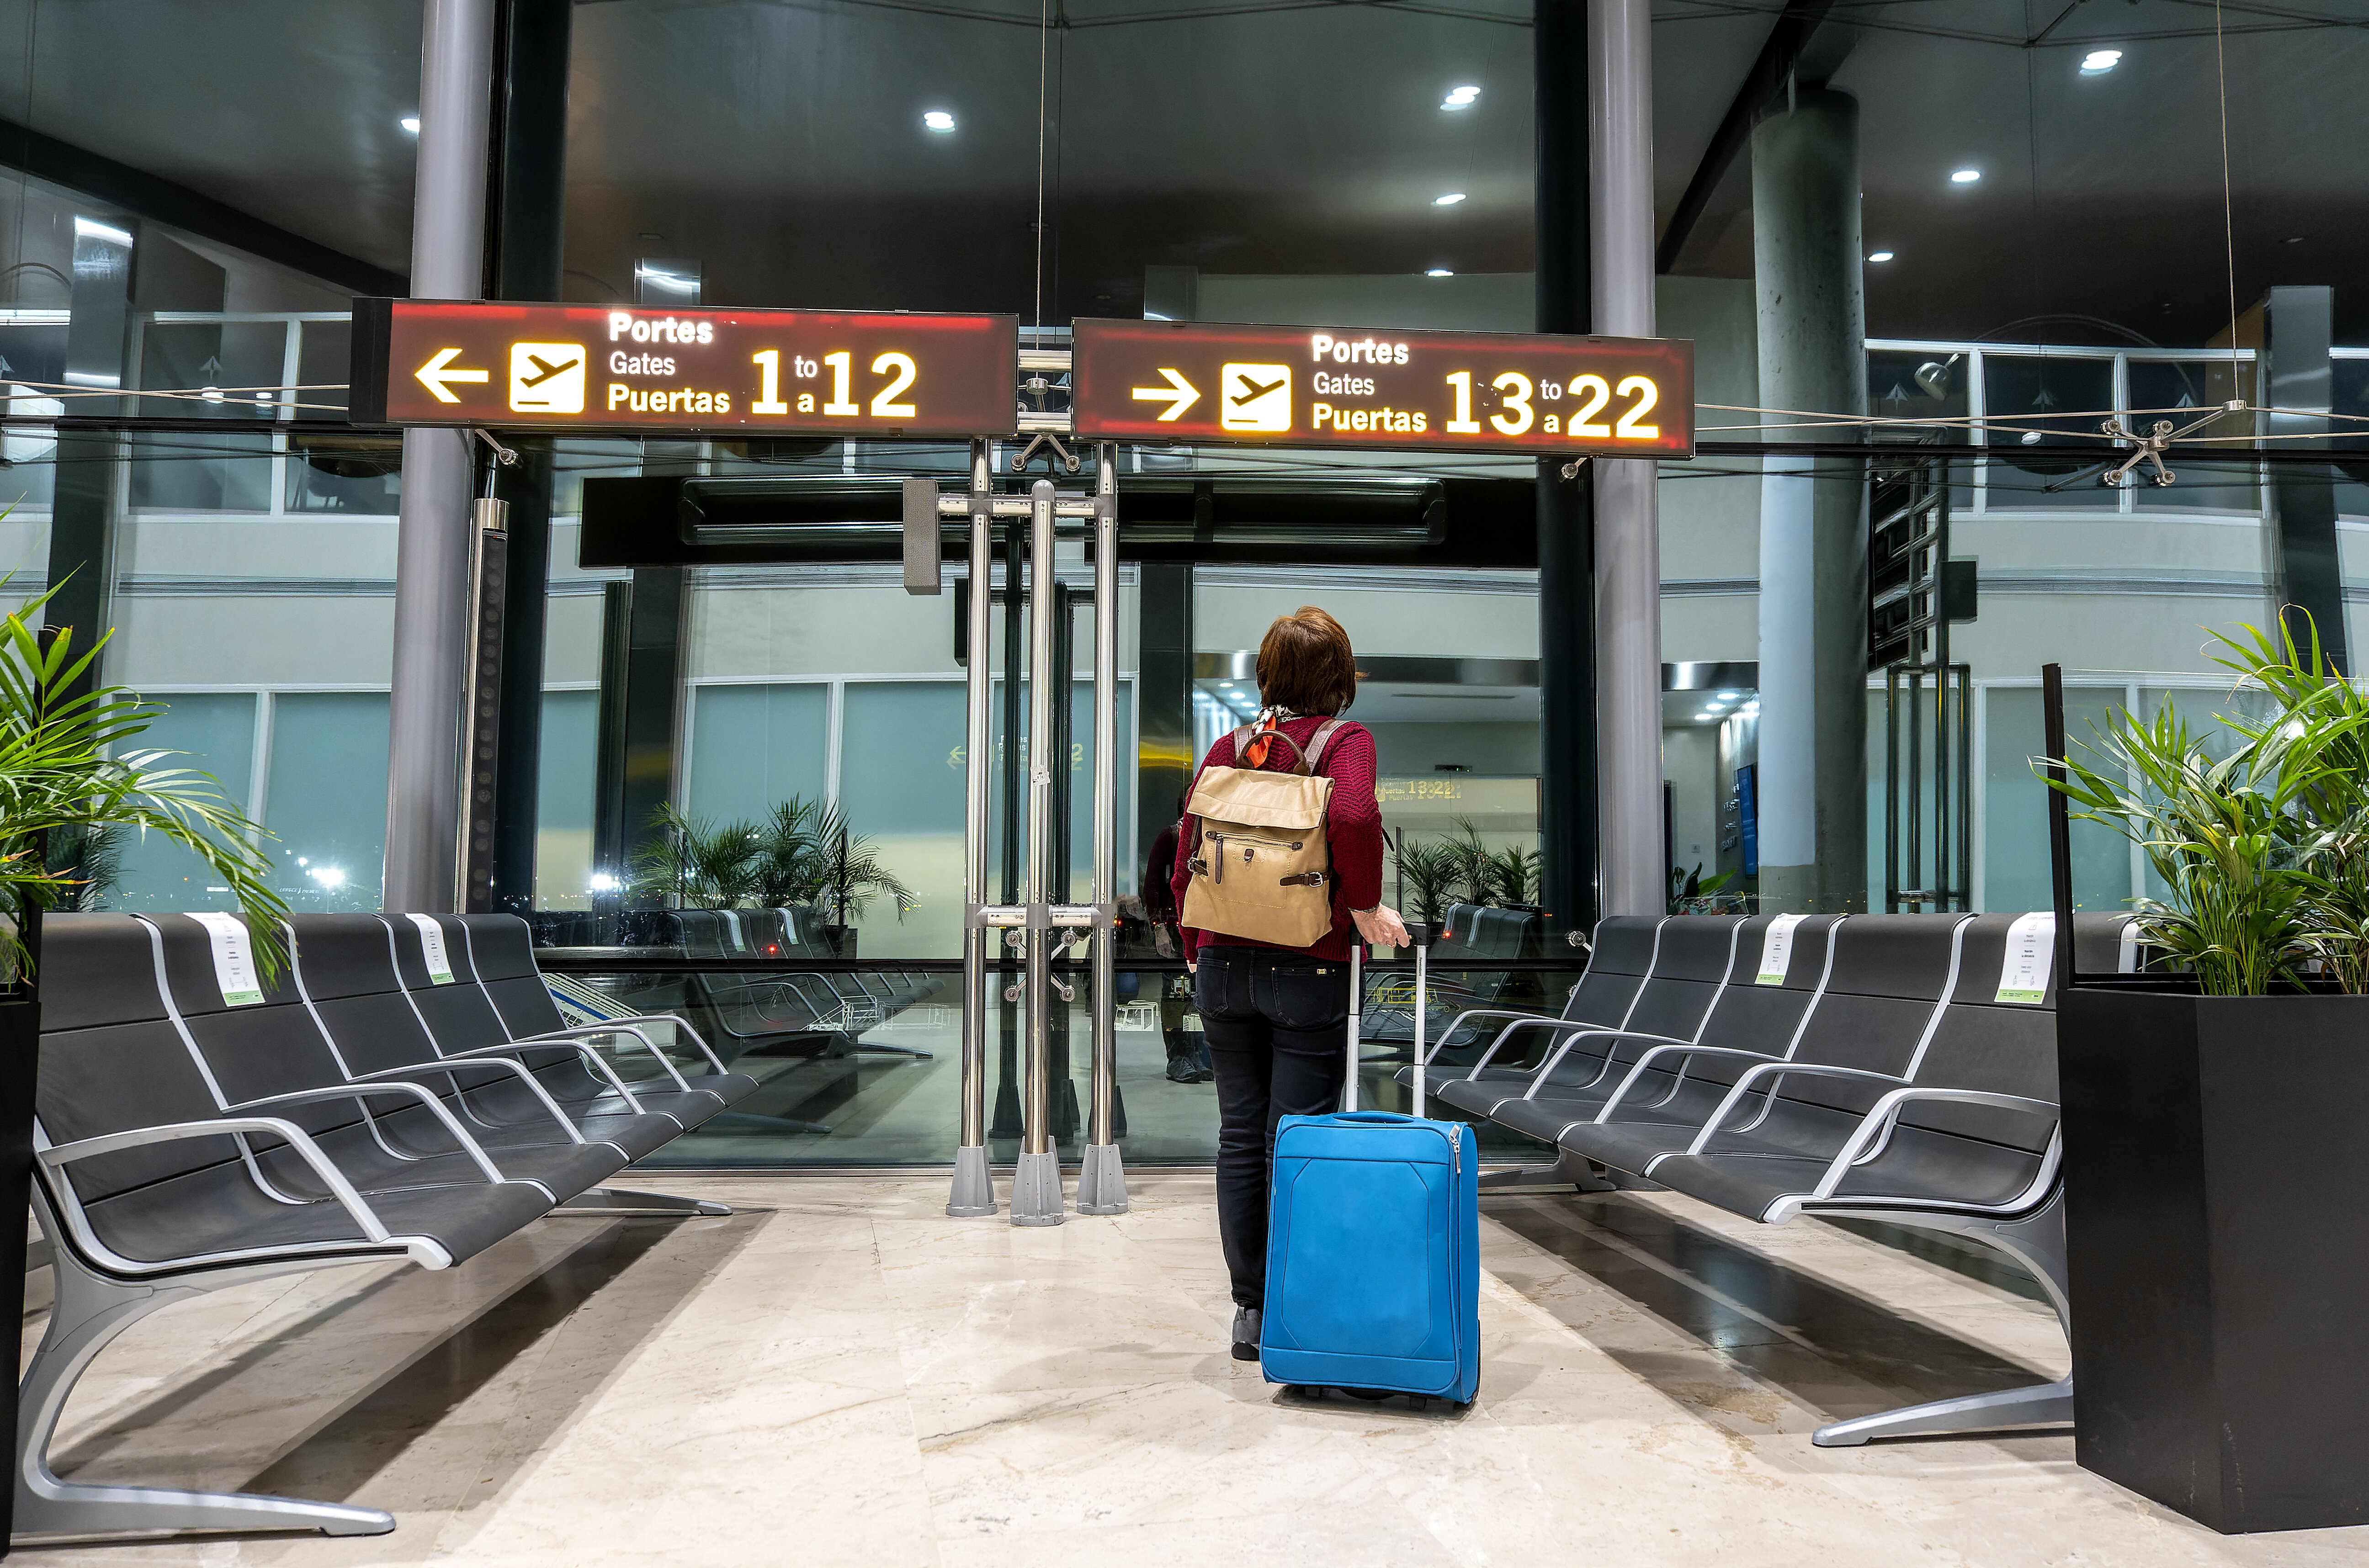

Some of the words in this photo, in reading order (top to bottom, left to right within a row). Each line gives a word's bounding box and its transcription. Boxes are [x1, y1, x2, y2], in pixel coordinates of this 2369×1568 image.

[609, 312, 713, 343] Portes
[610, 351, 675, 376] Gates
[1312, 334, 1409, 365] Portes
[608, 383, 731, 413] Puertas
[752, 350, 787, 414] 1
[795, 355, 818, 378] to
[823, 351, 916, 417] 12
[1313, 371, 1375, 396] Gates
[797, 393, 814, 413] a
[1312, 403, 1427, 432] Puertas
[1446, 371, 1534, 436] 13
[1540, 379, 1562, 400] to
[1567, 374, 1659, 439] 22
[1543, 414, 1559, 433] a
